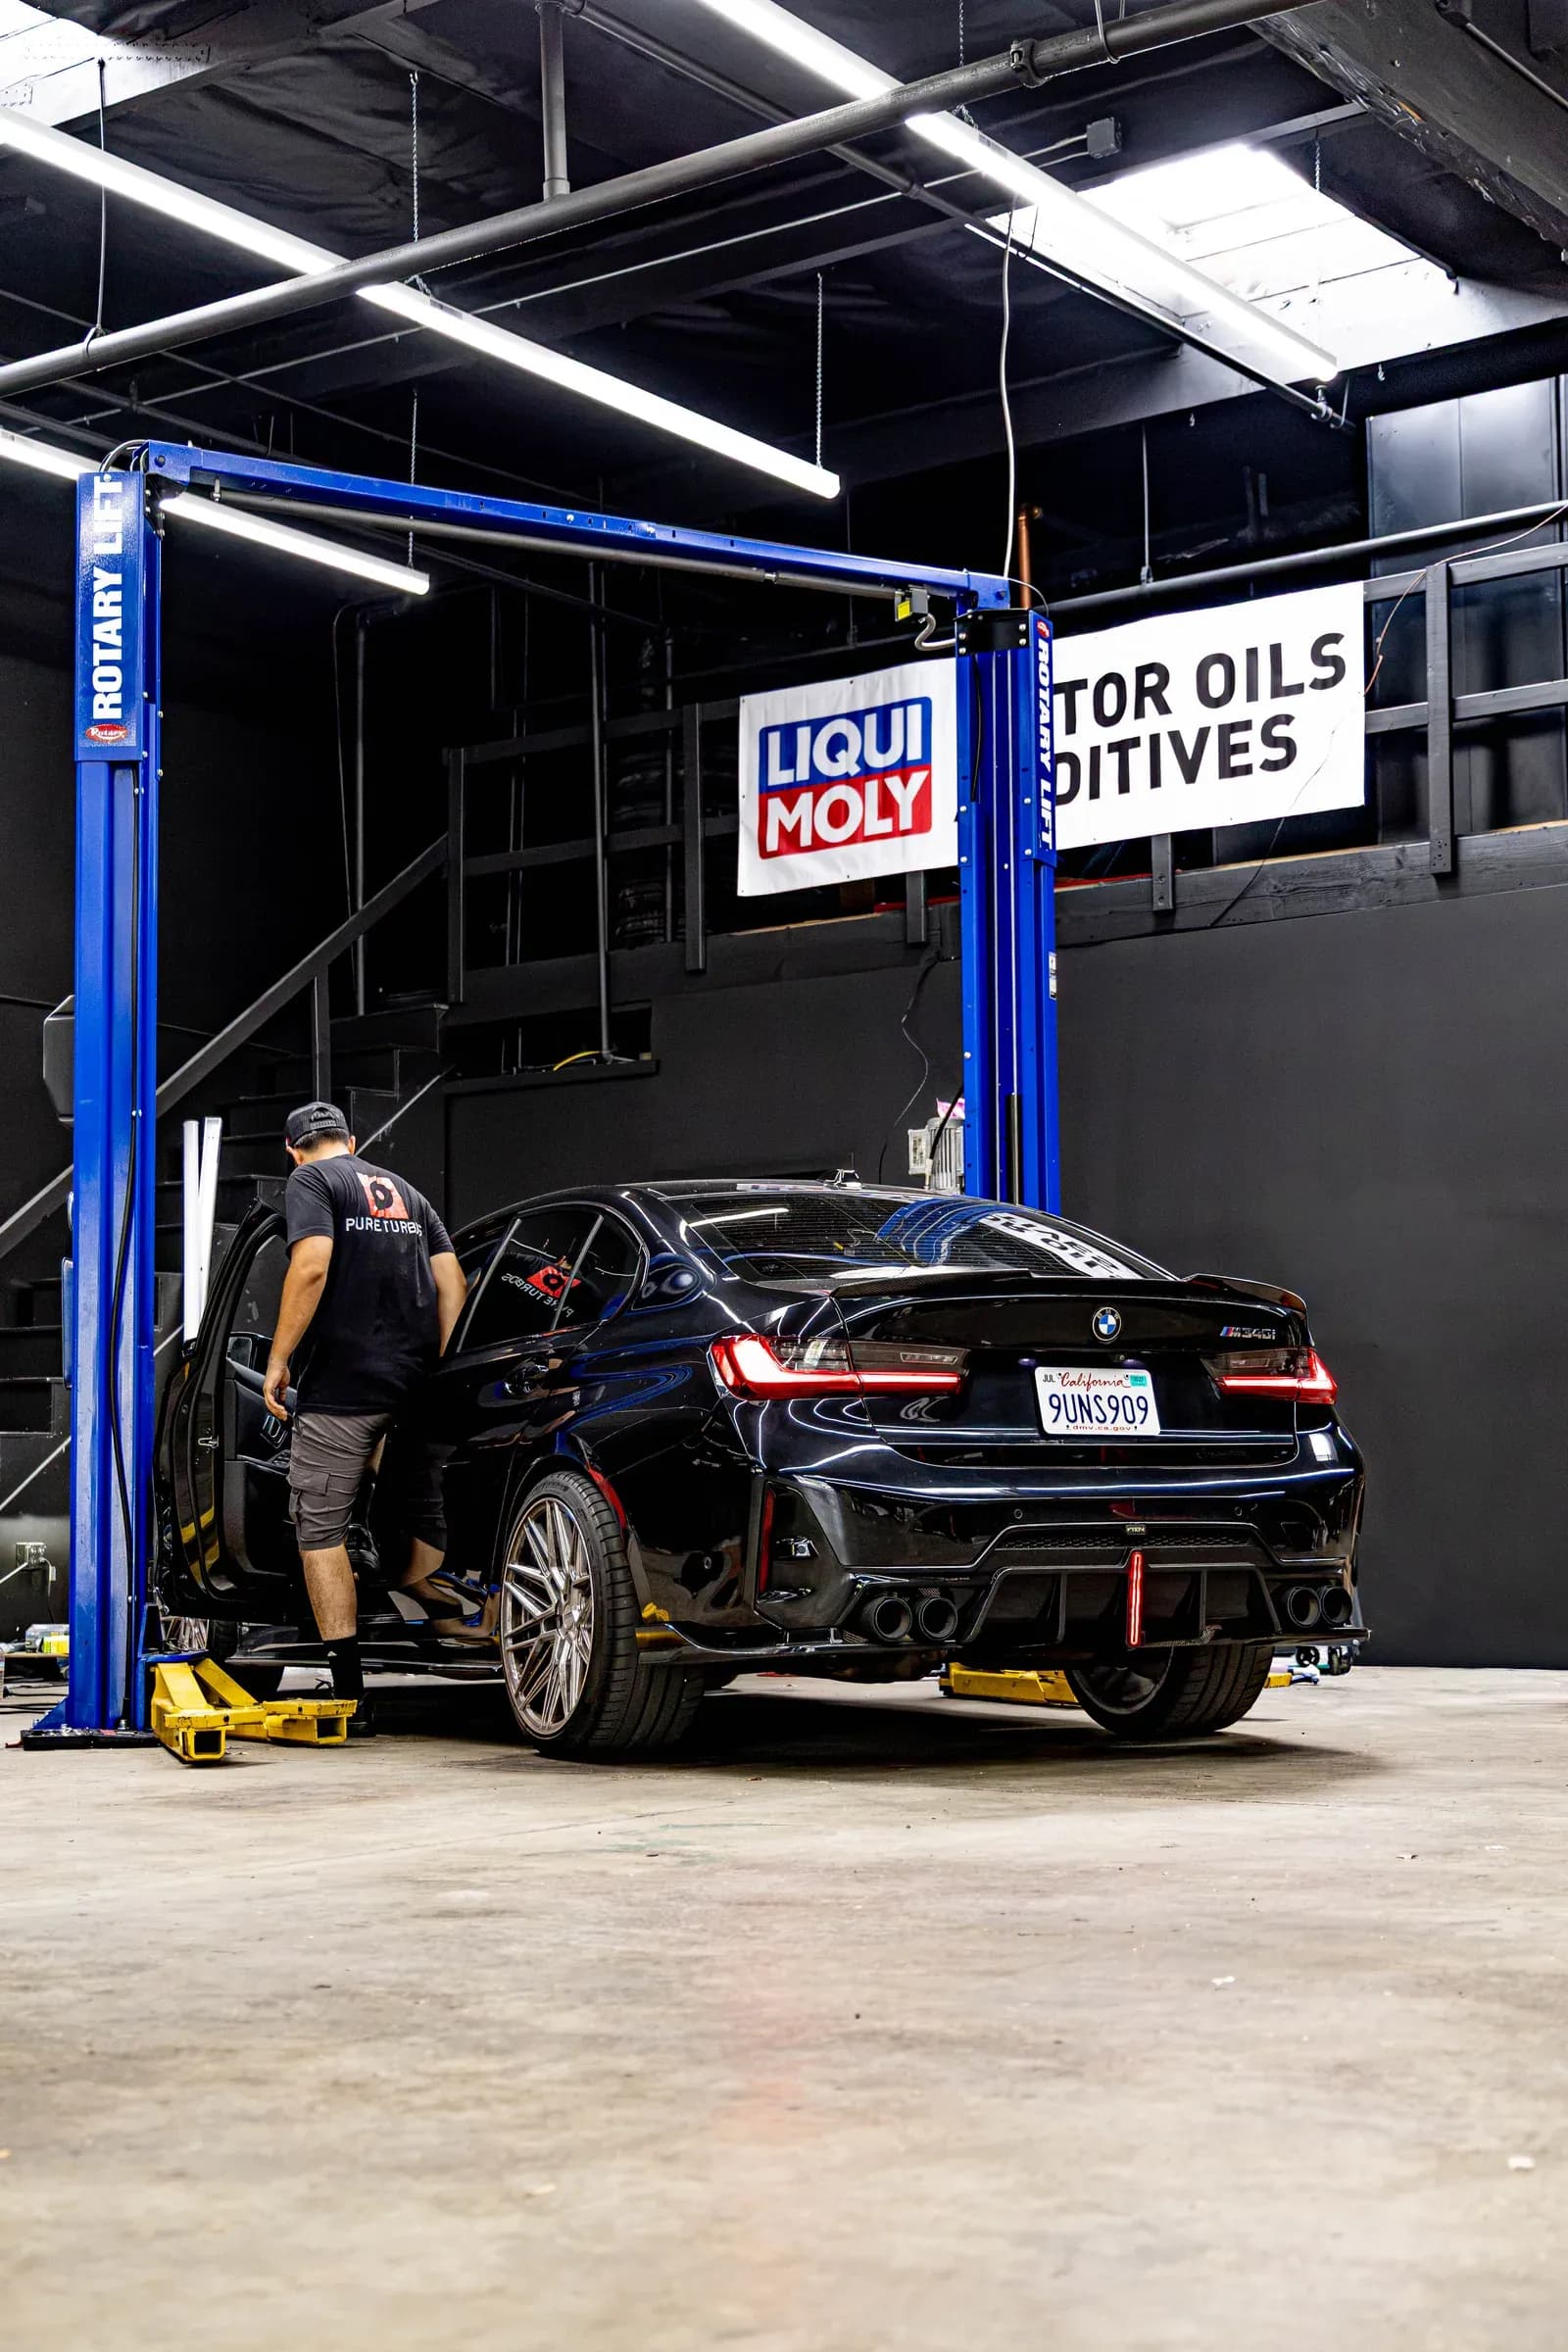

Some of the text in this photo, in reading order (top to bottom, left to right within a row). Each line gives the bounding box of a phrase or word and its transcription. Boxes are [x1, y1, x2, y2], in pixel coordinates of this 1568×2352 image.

[93, 476, 122, 719] ROTARY LIFT
[1038, 639, 1052, 772] ROTARY
[1196, 633, 1347, 709] OILS
[767, 704, 922, 786] LIQUI
[1055, 713, 1298, 806] DITIVES
[766, 770, 929, 852] MOLY
[1041, 779, 1053, 851] LIFT
[1043, 1374, 1055, 1383] JUL
[1061, 1372, 1131, 1392] California
[1049, 1394, 1149, 1424] 9UNS909
